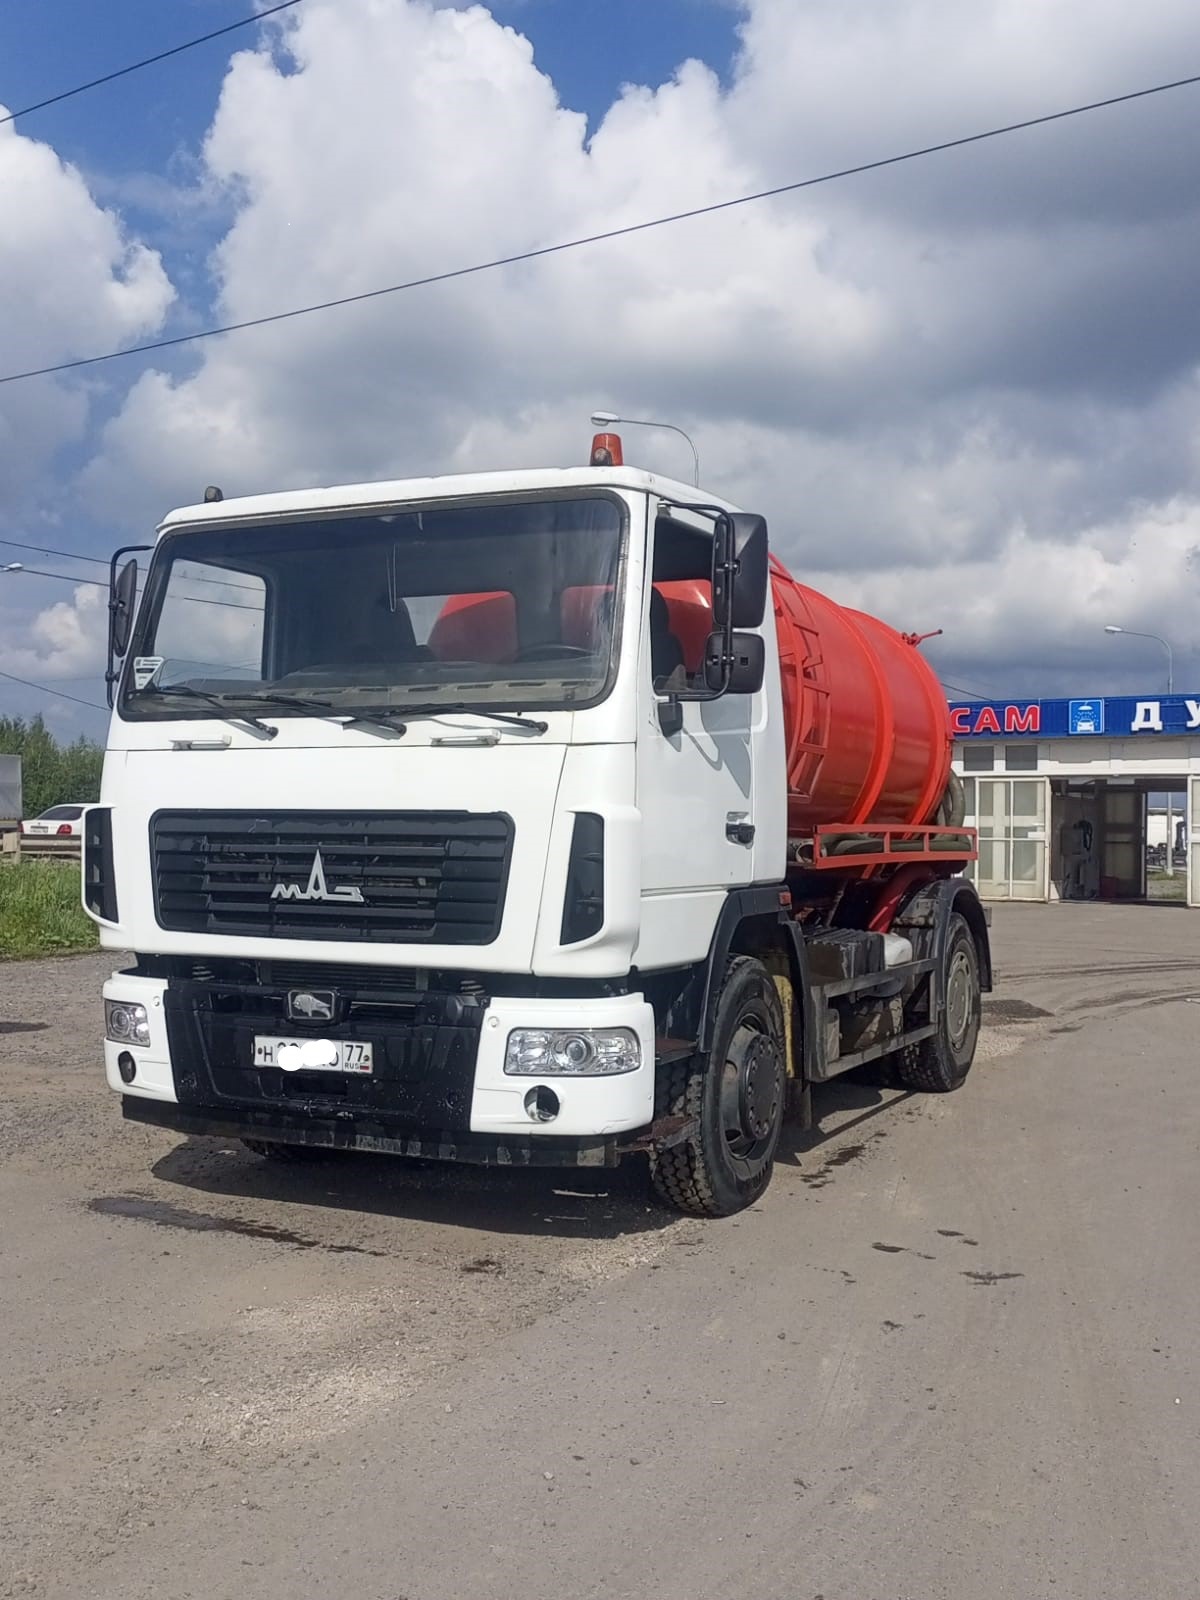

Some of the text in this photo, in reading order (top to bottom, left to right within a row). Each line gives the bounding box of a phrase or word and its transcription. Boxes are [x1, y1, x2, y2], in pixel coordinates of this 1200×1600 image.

[950, 704, 1040, 733] САМ
[345, 1044, 364, 1062] 77
[344, 1062, 360, 1070] RUS
